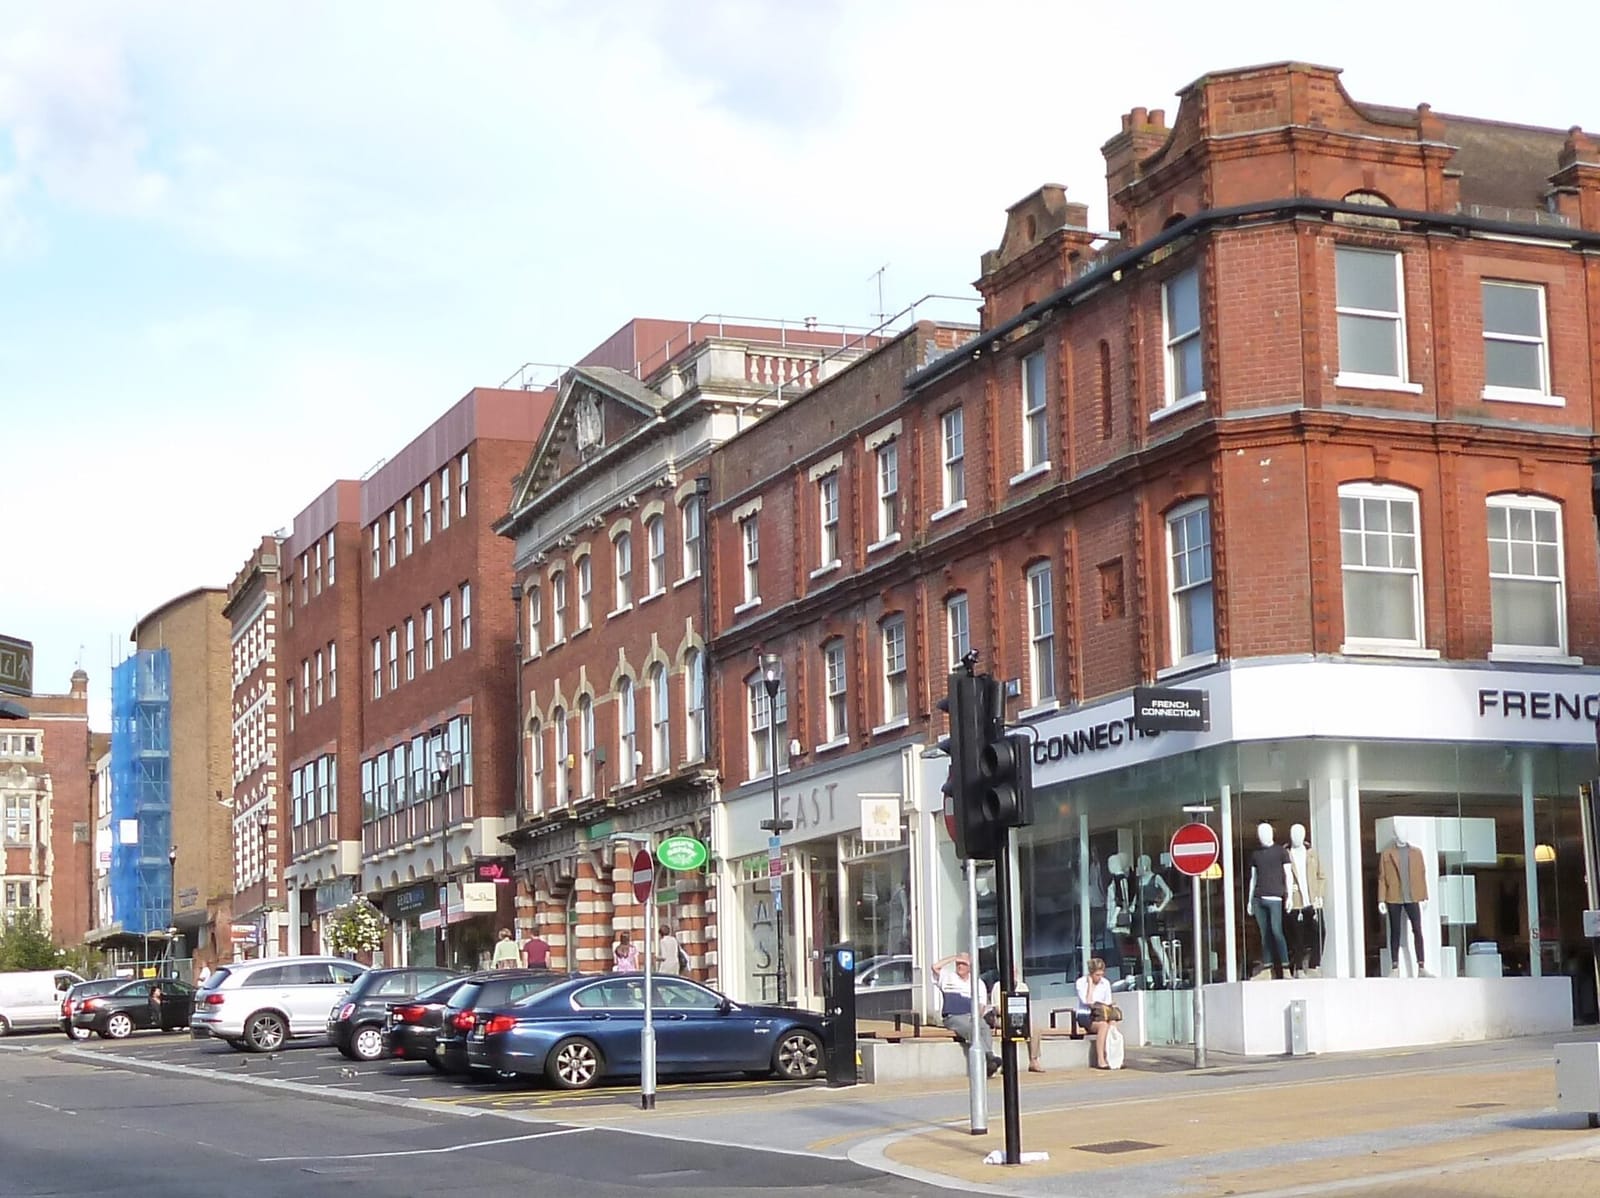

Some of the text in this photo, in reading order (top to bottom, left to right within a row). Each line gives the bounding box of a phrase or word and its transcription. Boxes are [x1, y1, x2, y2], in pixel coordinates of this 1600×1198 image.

[1141, 707, 1201, 717] CONNECTION
[1479, 689, 1599, 720] FRENC
[1033, 716, 1161, 765] CONNECT
[841, 951, 851, 967] P
